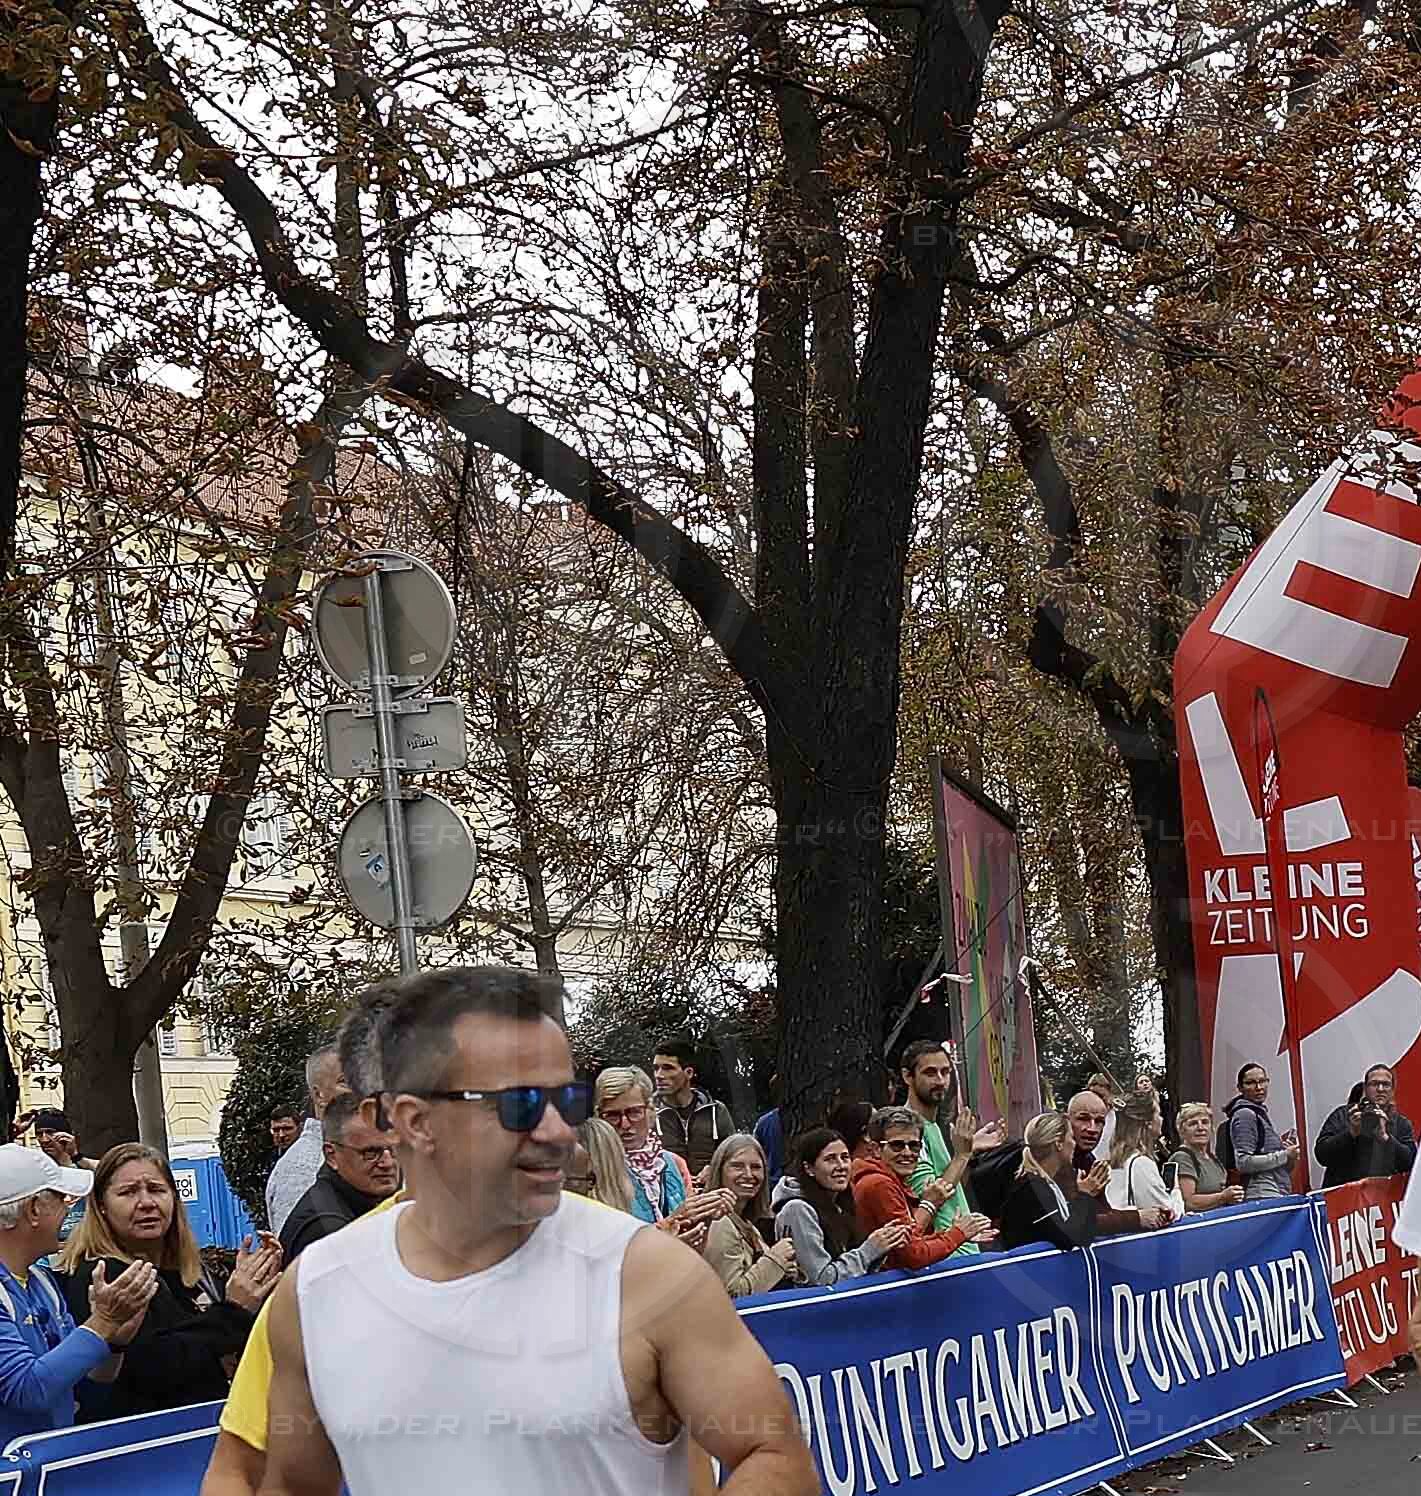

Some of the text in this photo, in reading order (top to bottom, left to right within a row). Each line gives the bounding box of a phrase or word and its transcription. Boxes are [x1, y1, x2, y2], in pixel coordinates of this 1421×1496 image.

[1204, 861, 1366, 905] KLEINE
[1327, 1205, 1386, 1285] LEINE
[1112, 1250, 1326, 1403] PUNTIGAMER
